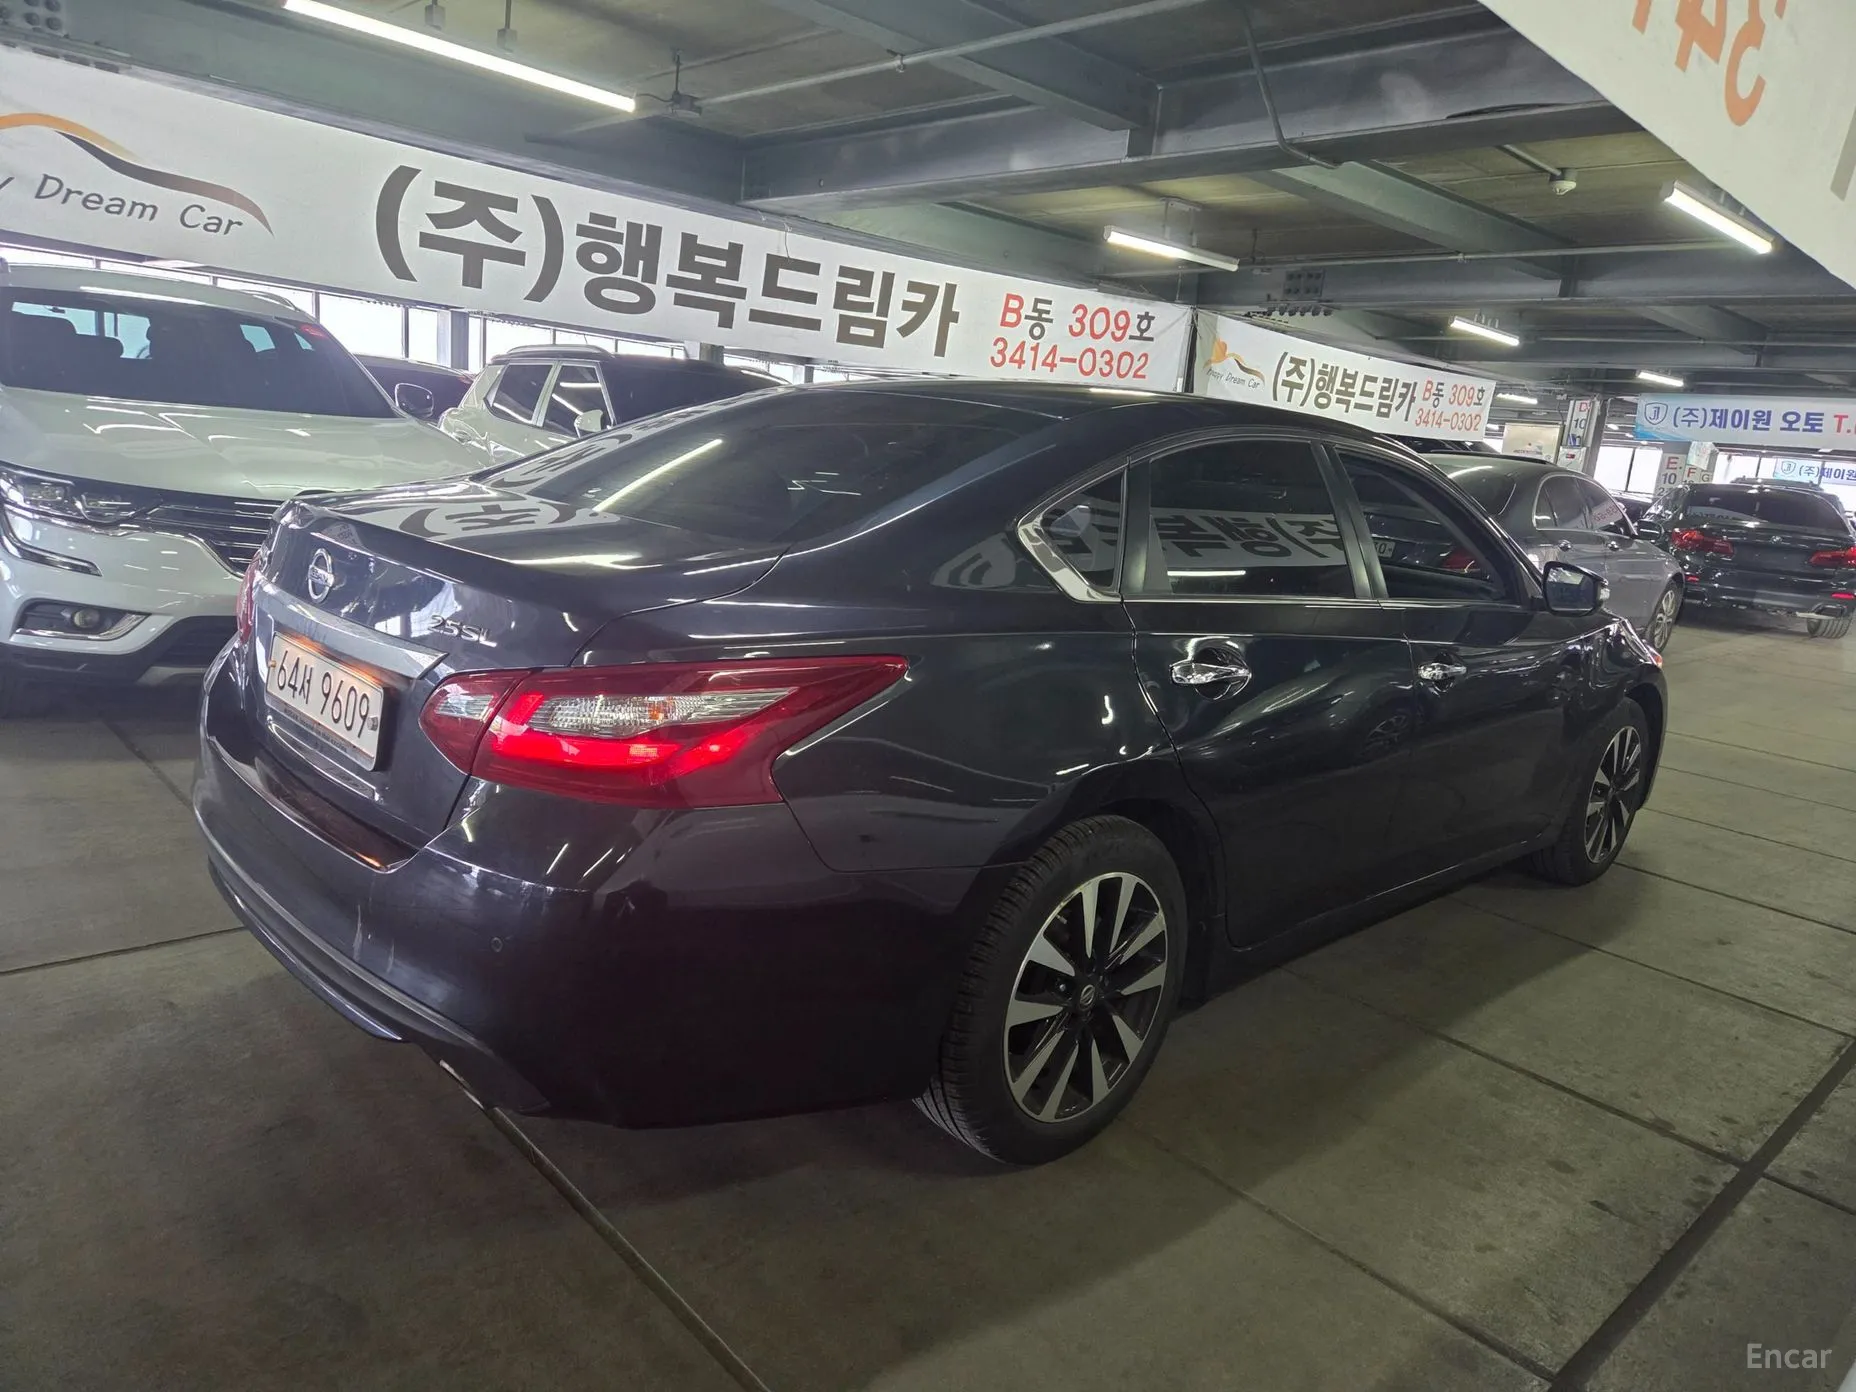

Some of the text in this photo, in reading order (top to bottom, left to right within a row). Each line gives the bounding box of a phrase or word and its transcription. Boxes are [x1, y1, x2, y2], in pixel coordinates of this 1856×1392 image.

[34, 173, 243, 235] Dream Car
[376, 165, 960, 357] (주)행복드림카
[1000, 293, 1156, 342] B동 309호
[990, 337, 1149, 379] 3414-0302
[1273, 352, 1417, 422] (주)행복드림카
[1423, 380, 1486, 408] B동 309호
[1415, 408, 1483, 432] 3414-0302
[1672, 406, 1772, 432] (주)제이원
[1780, 411, 1825, 434] 오토
[1661, 472, 1677, 485] 10
[277, 650, 313, 705] 64서
[321, 671, 371, 739] 9609
